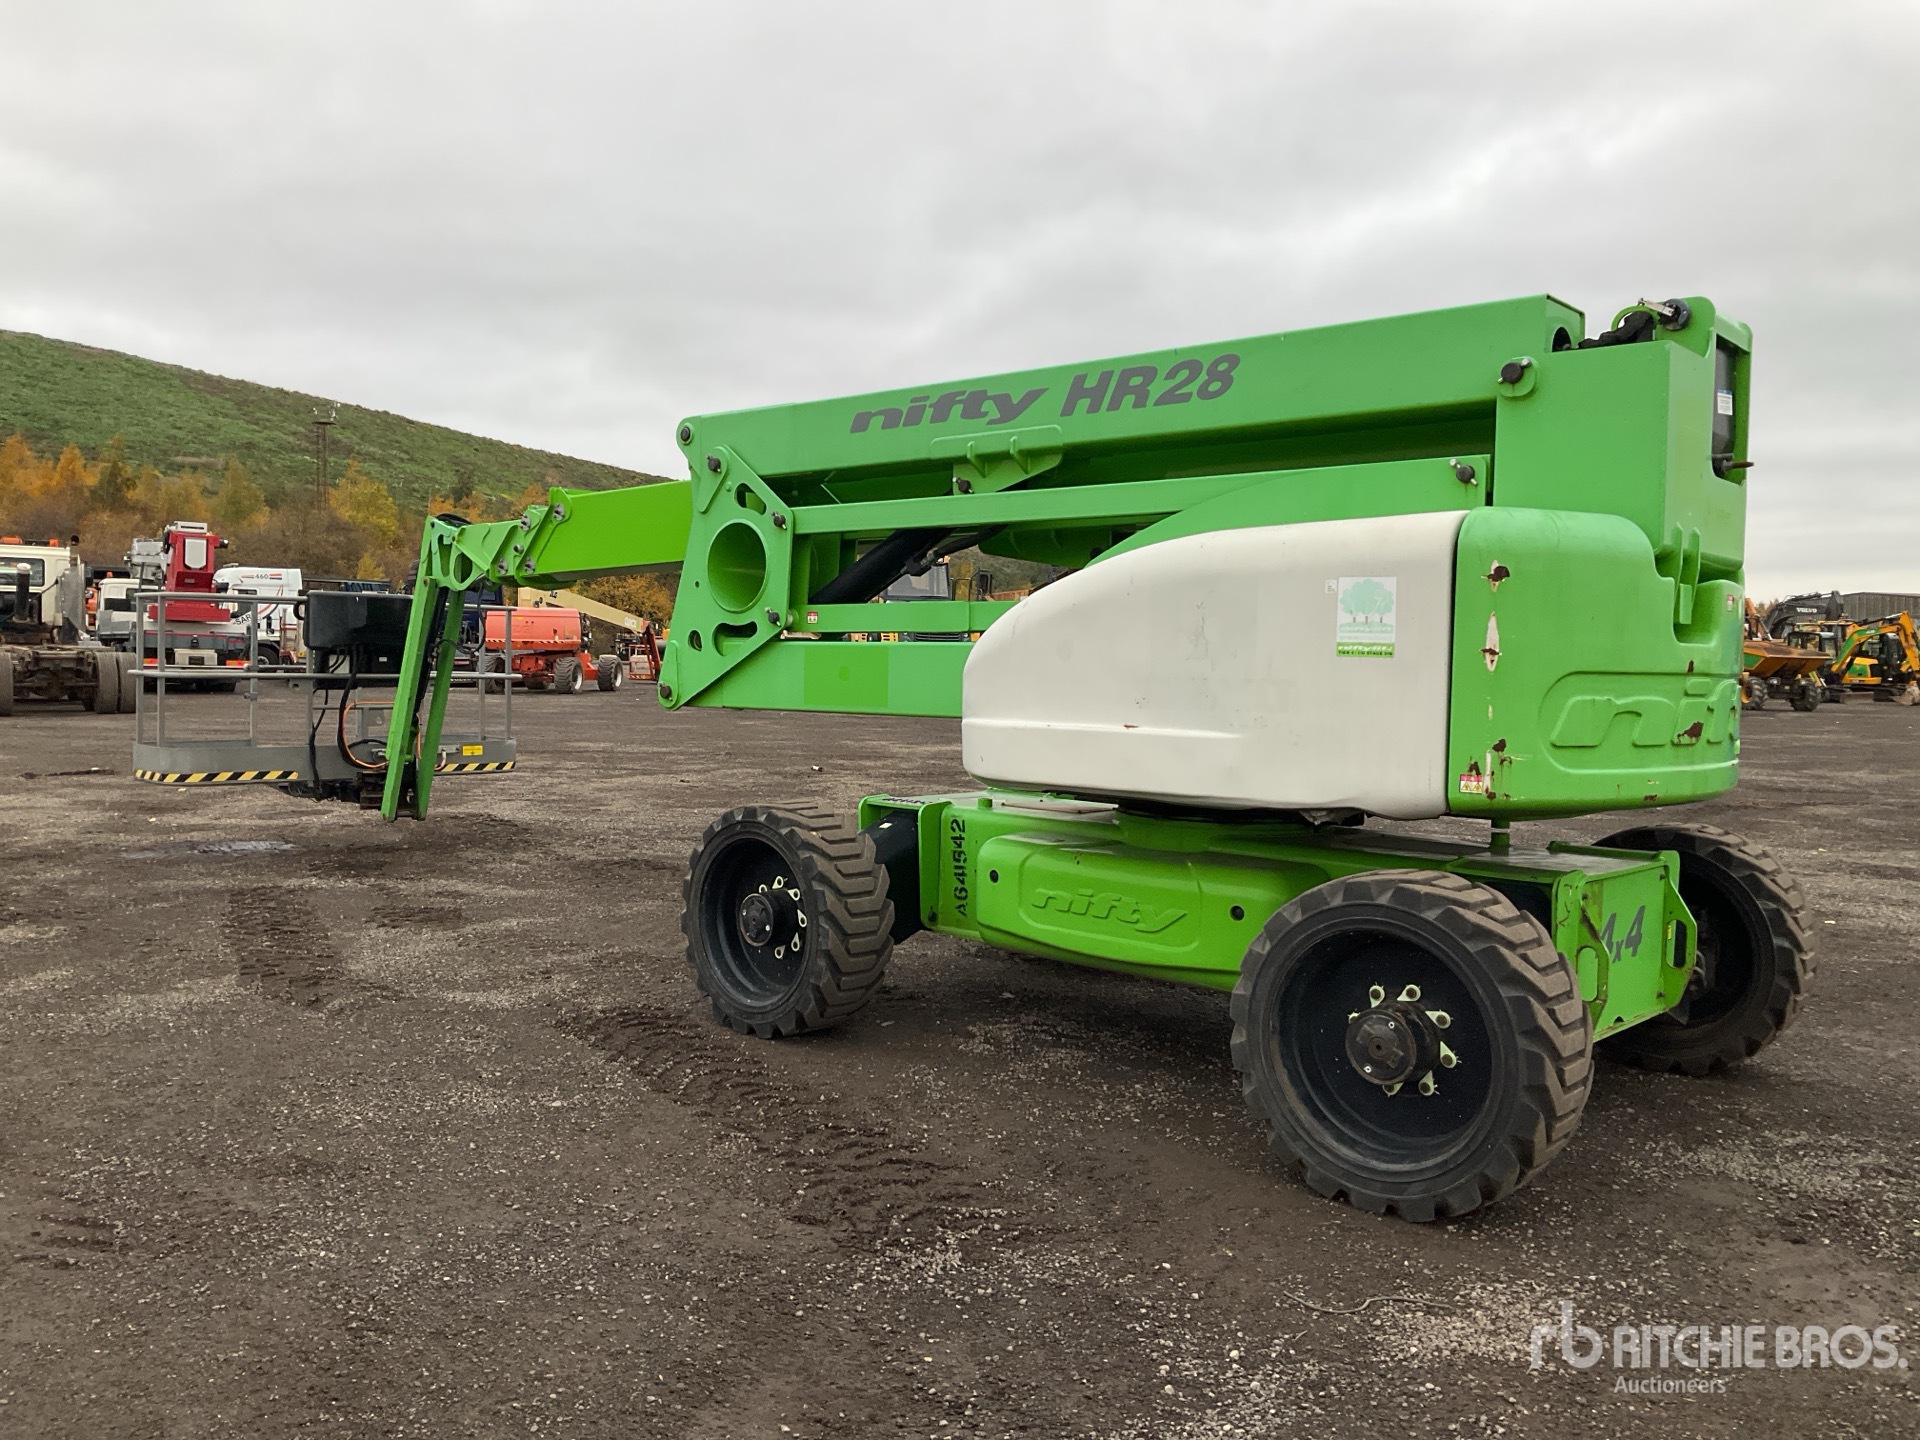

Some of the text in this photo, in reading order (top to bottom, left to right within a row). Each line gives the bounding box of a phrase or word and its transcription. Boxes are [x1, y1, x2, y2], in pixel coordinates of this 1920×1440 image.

[849, 353, 1241, 434] nifty HR28
[1032, 888, 1187, 933] nifty
